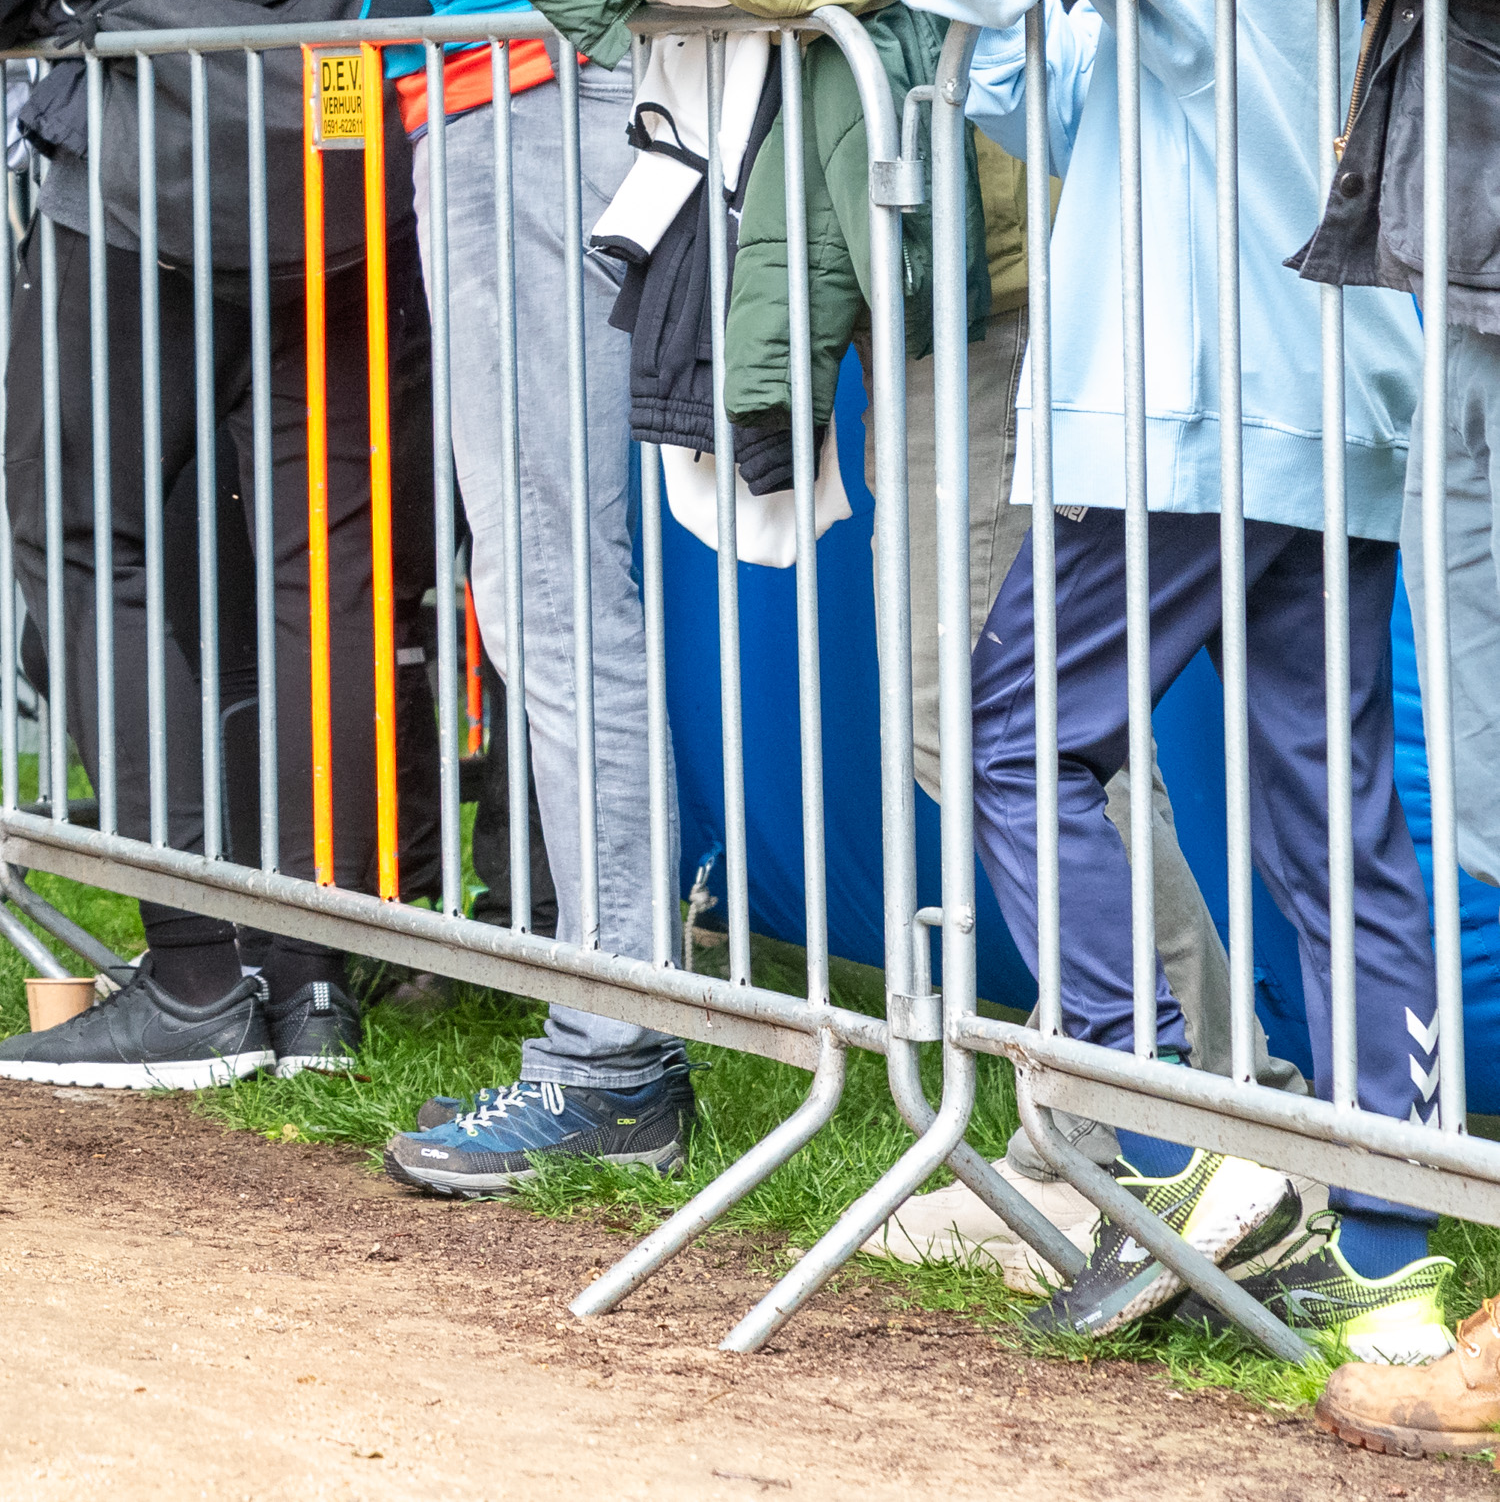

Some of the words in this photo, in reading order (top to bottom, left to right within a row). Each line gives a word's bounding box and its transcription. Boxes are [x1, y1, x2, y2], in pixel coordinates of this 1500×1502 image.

[321, 59, 362, 92] D.E.V.
[322, 96, 363, 114] VERHUUR
[323, 118, 364, 134] 0591-622611
